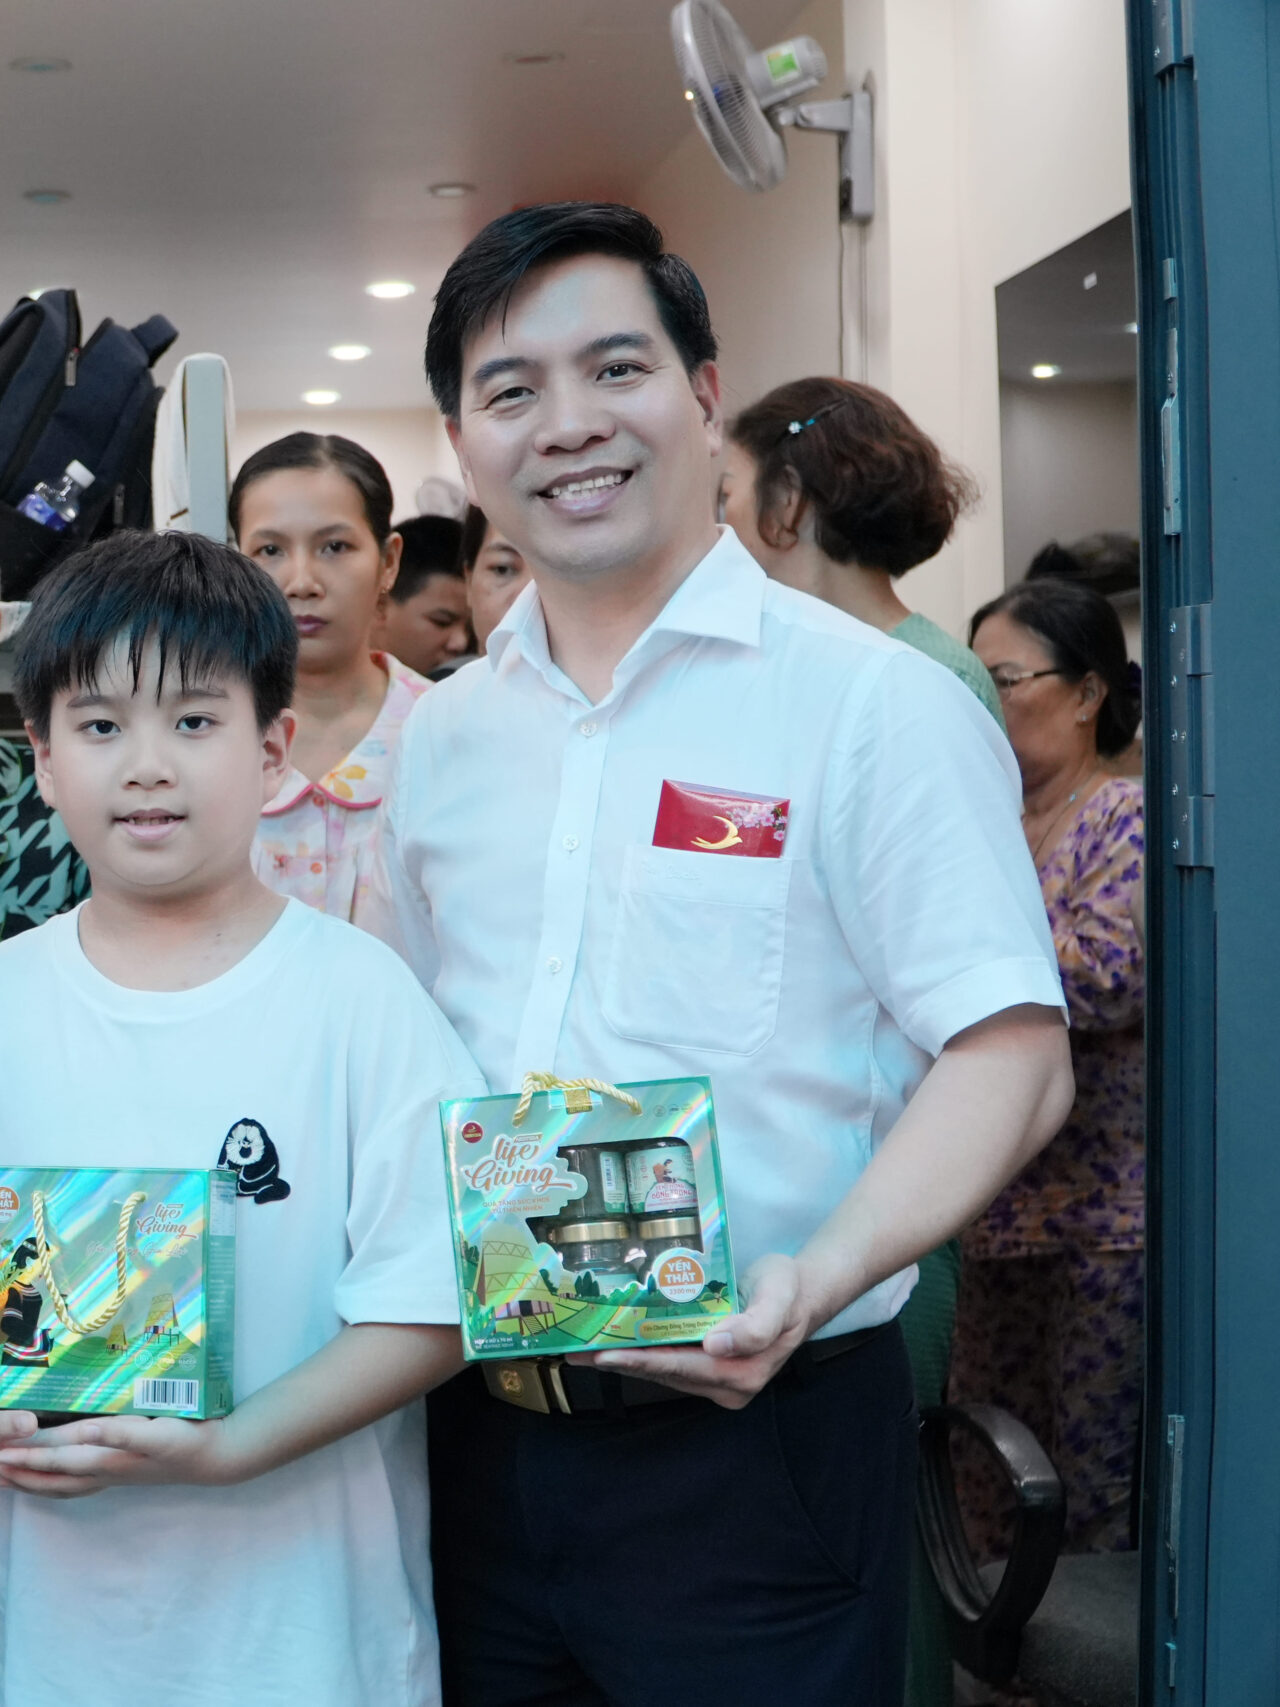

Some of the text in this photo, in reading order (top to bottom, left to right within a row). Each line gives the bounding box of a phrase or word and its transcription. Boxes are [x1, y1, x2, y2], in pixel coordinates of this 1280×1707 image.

[495, 1138, 540, 1168] life
[464, 1159, 573, 1192] Giving
[154, 1203, 181, 1221] life
[136, 1215, 197, 1239] Giving
[667, 1259, 692, 1273] YẾN
[665, 1271, 696, 1285] THẬT
